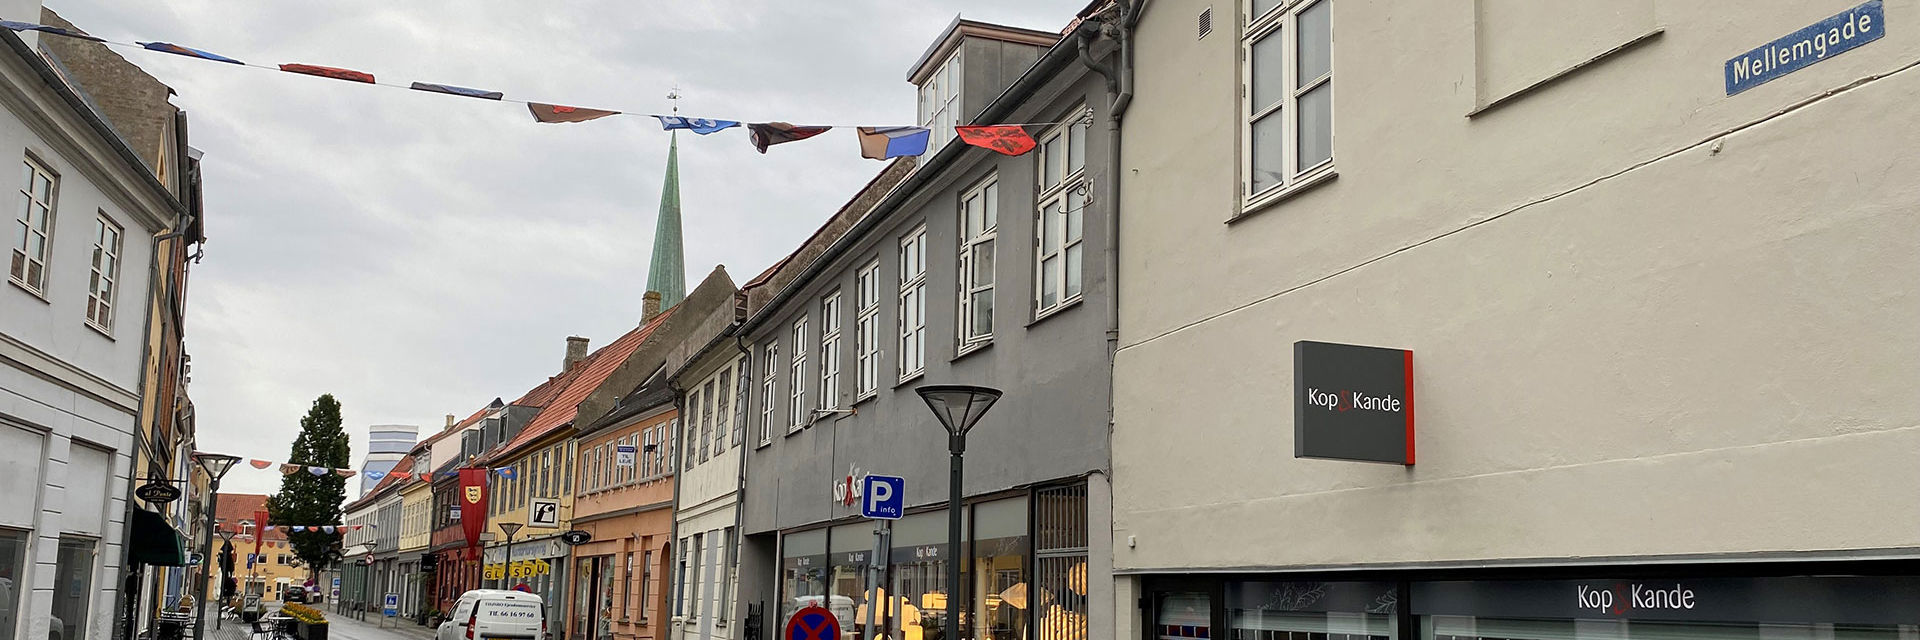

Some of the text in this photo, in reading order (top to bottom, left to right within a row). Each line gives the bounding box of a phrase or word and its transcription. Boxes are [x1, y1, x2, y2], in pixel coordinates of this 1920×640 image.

[1733, 12, 1872, 85] Mellemgade
[1308, 387, 1339, 411] Kop
[1353, 391, 1401, 412] Kande
[833, 478, 847, 506] Kop
[869, 481, 893, 512] P
[484, 564, 545, 579] GLSDU
[1577, 584, 1613, 614] Kop
[1631, 583, 1695, 609] Kande
